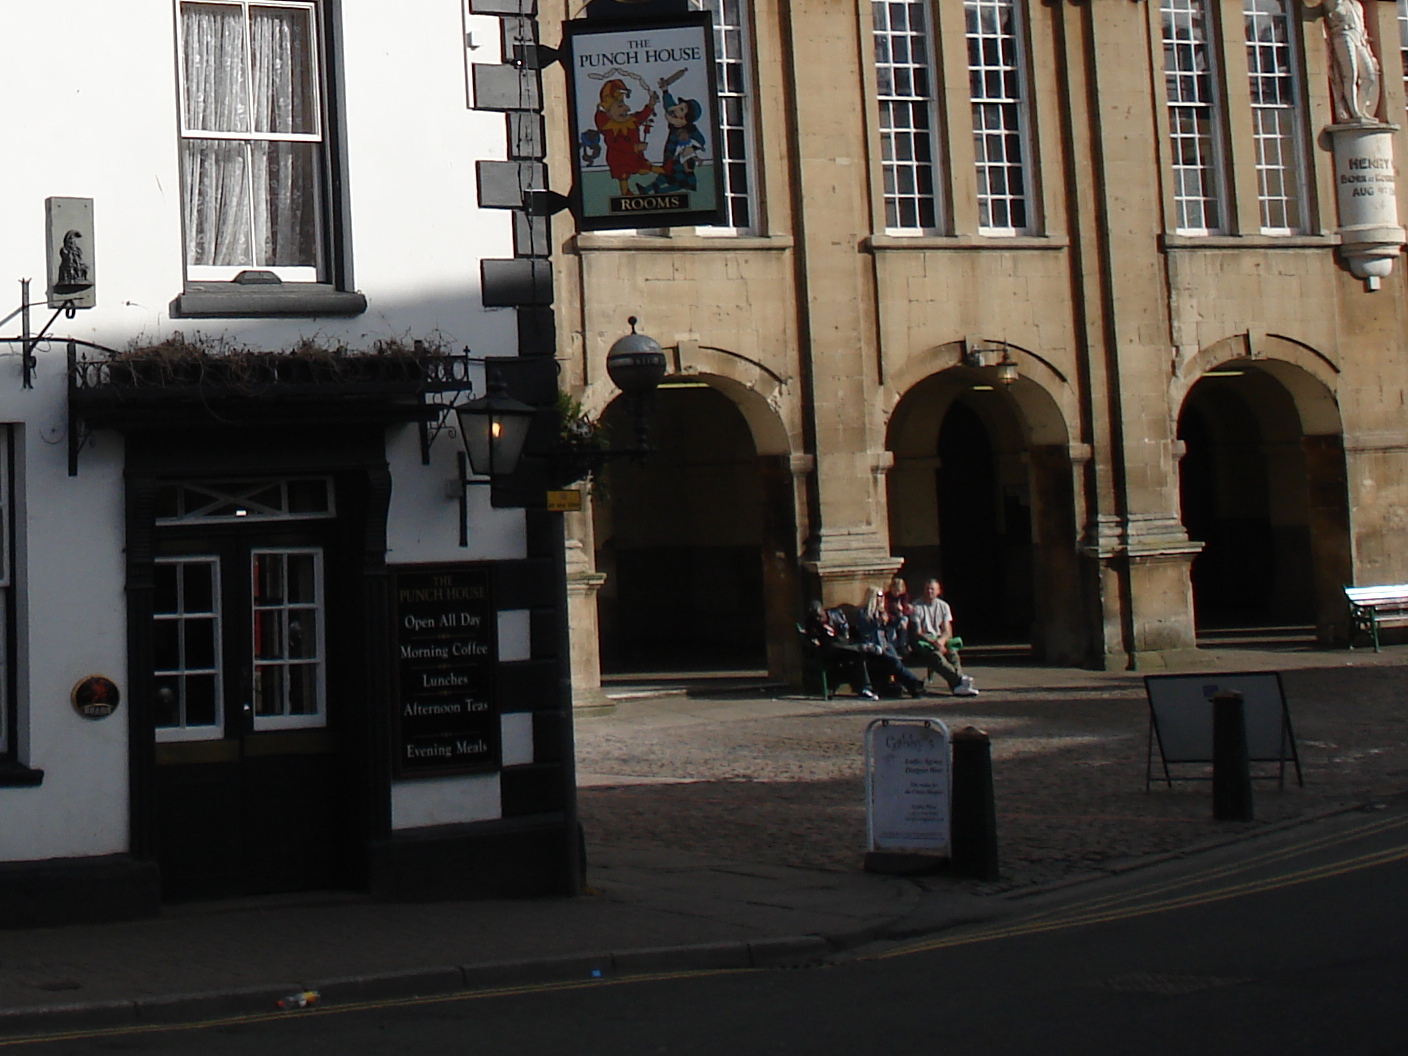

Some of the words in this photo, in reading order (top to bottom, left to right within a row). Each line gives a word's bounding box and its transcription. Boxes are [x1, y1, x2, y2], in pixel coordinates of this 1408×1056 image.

[627, 39, 651, 49] THE
[579, 50, 639, 67] PUNCH
[645, 47, 701, 63] HOUSE
[1348, 157, 1389, 170] HENRY
[1352, 186, 1374, 198] AUG
[621, 196, 680, 211] ROOMS
[433, 575, 453, 586] THE
[400, 588, 443, 602] PUNCH
[446, 585, 485, 600] HOUSE
[405, 614, 435, 631] Open
[440, 612, 456, 627] All
[460, 612, 481, 628] Day
[400, 644, 449, 659] Morning
[452, 641, 488, 656] Coffee
[422, 672, 469, 688] Lunches
[404, 701, 461, 716] Afternoon
[465, 697, 489, 712] Teas
[406, 743, 452, 758] Evening
[455, 739, 488, 755] Meals
